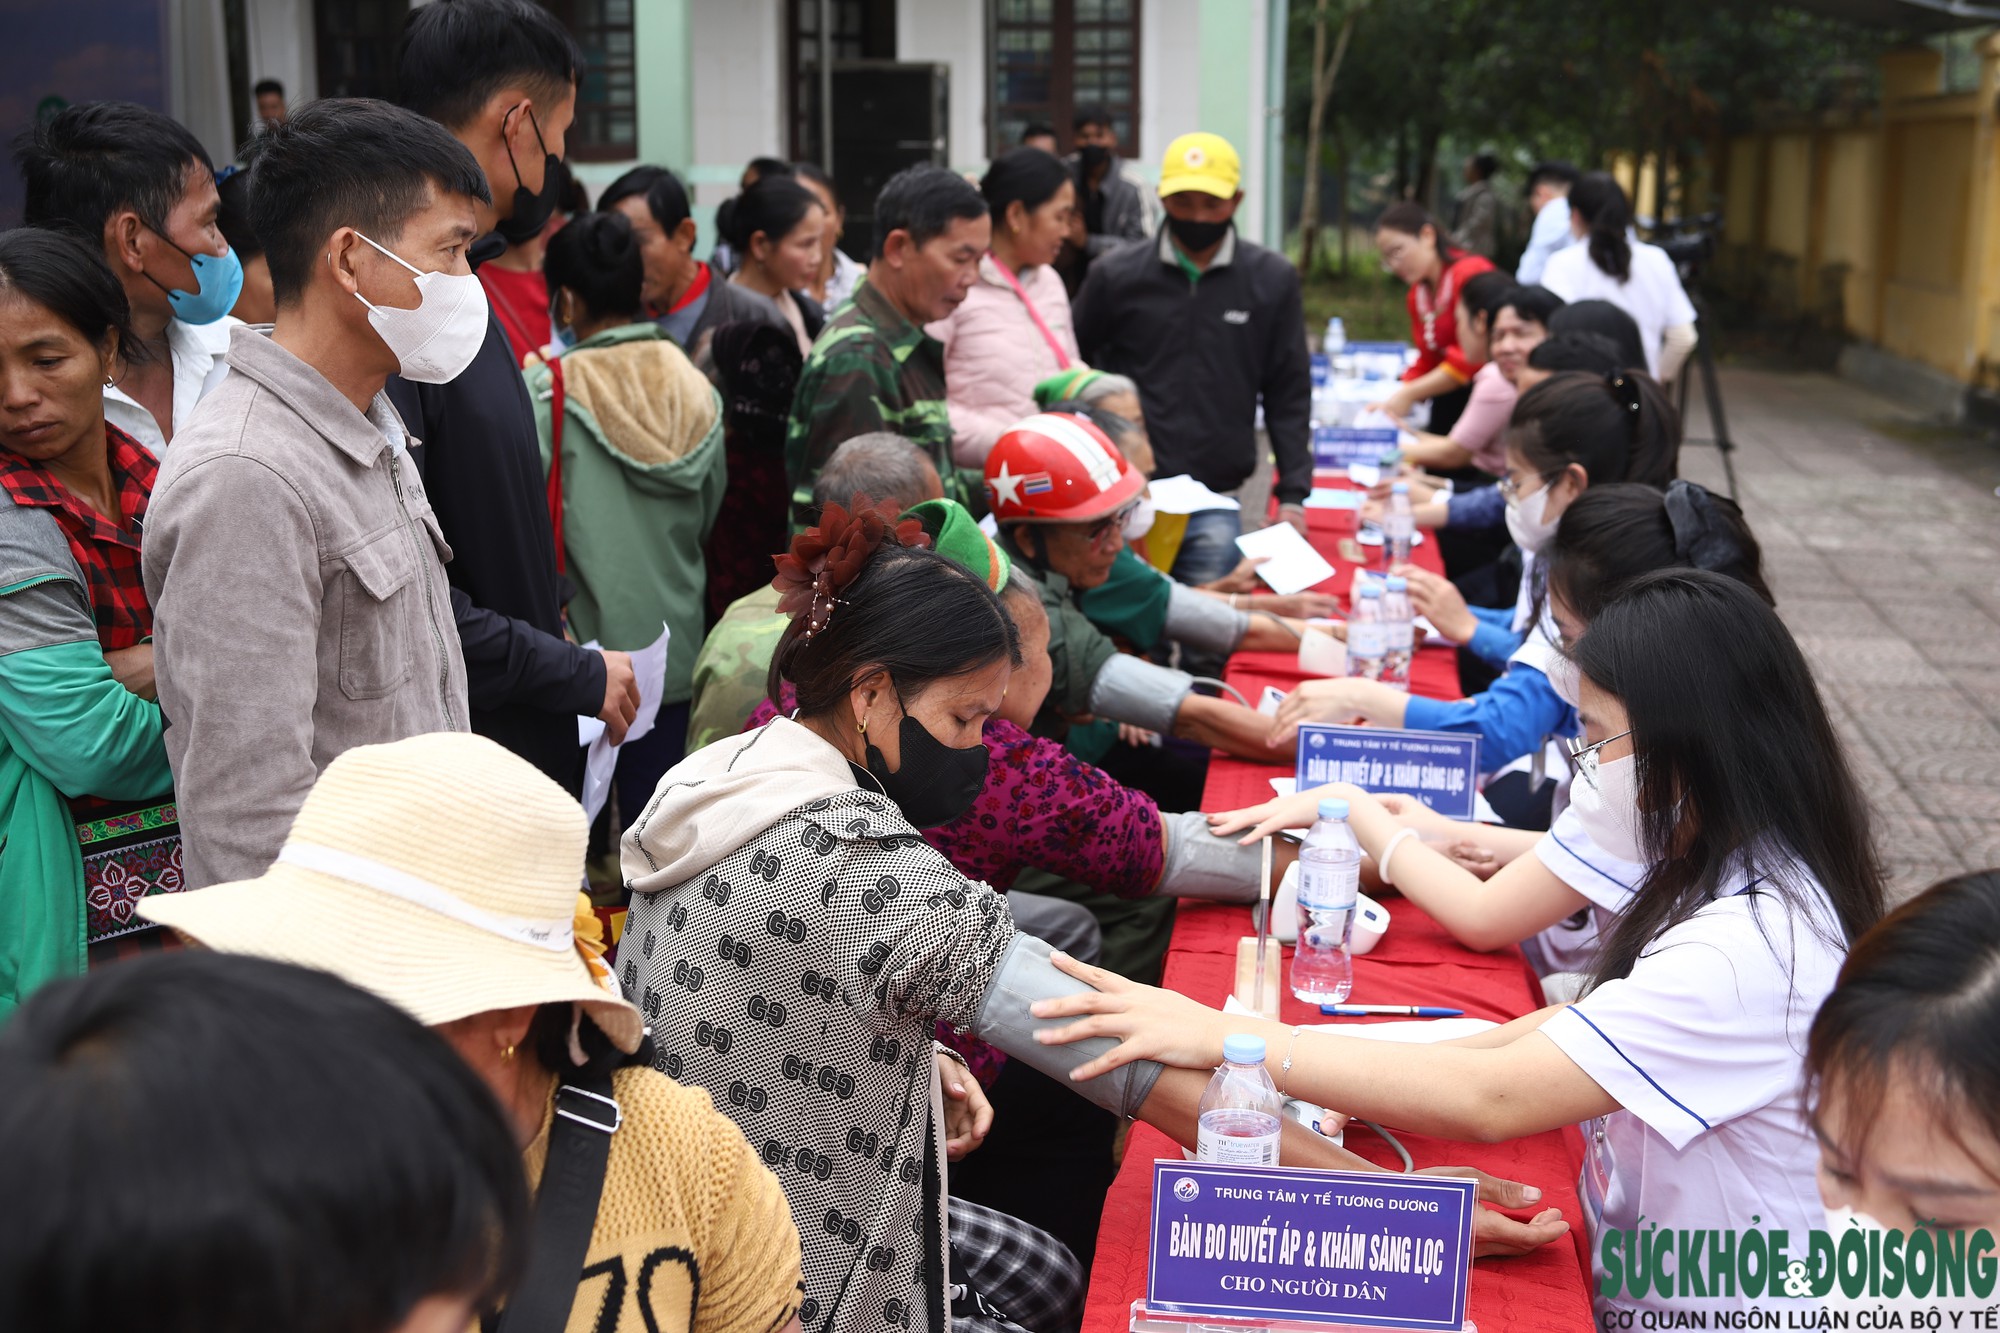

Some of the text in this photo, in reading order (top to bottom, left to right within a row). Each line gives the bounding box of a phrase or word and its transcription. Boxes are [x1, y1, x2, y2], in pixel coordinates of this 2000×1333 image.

[1214, 1187, 1439, 1213] TRUNG TÂM Y TẾ TƯƠNG DƯƠNG
[1169, 1213, 1445, 1284] BÀN ĐO HUYẾT ÁP & KHÁM SÀNG LỌC
[1220, 1274, 1387, 1301] CHO NGƯỜI DÂN
